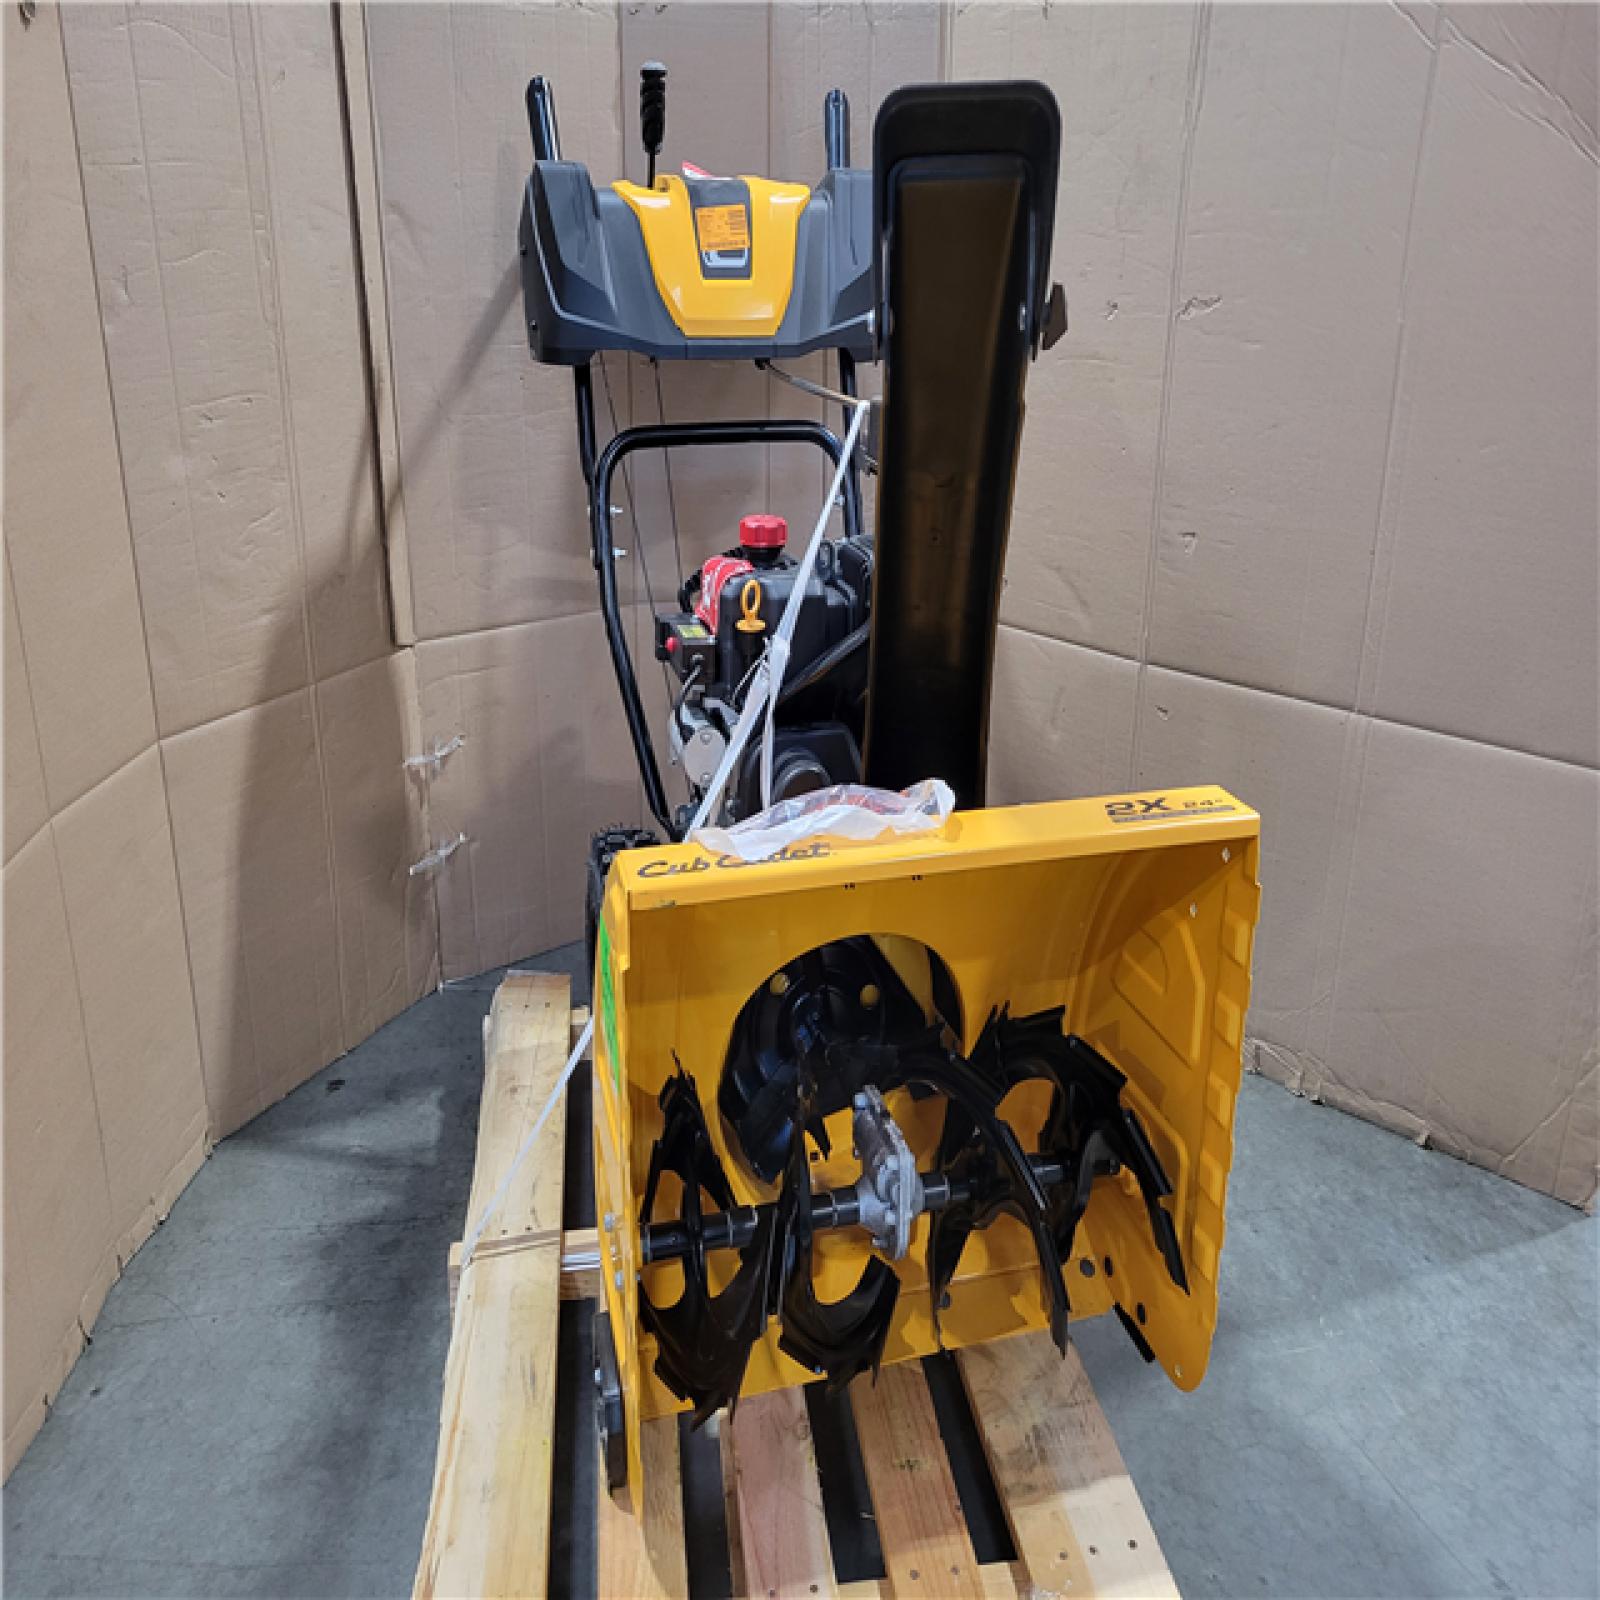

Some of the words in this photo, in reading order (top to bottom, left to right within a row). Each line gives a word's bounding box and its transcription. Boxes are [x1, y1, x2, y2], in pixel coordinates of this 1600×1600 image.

[1104, 797, 1171, 816] 2X
[637, 857, 711, 877] Cub
[716, 842, 831, 867] Cdet
